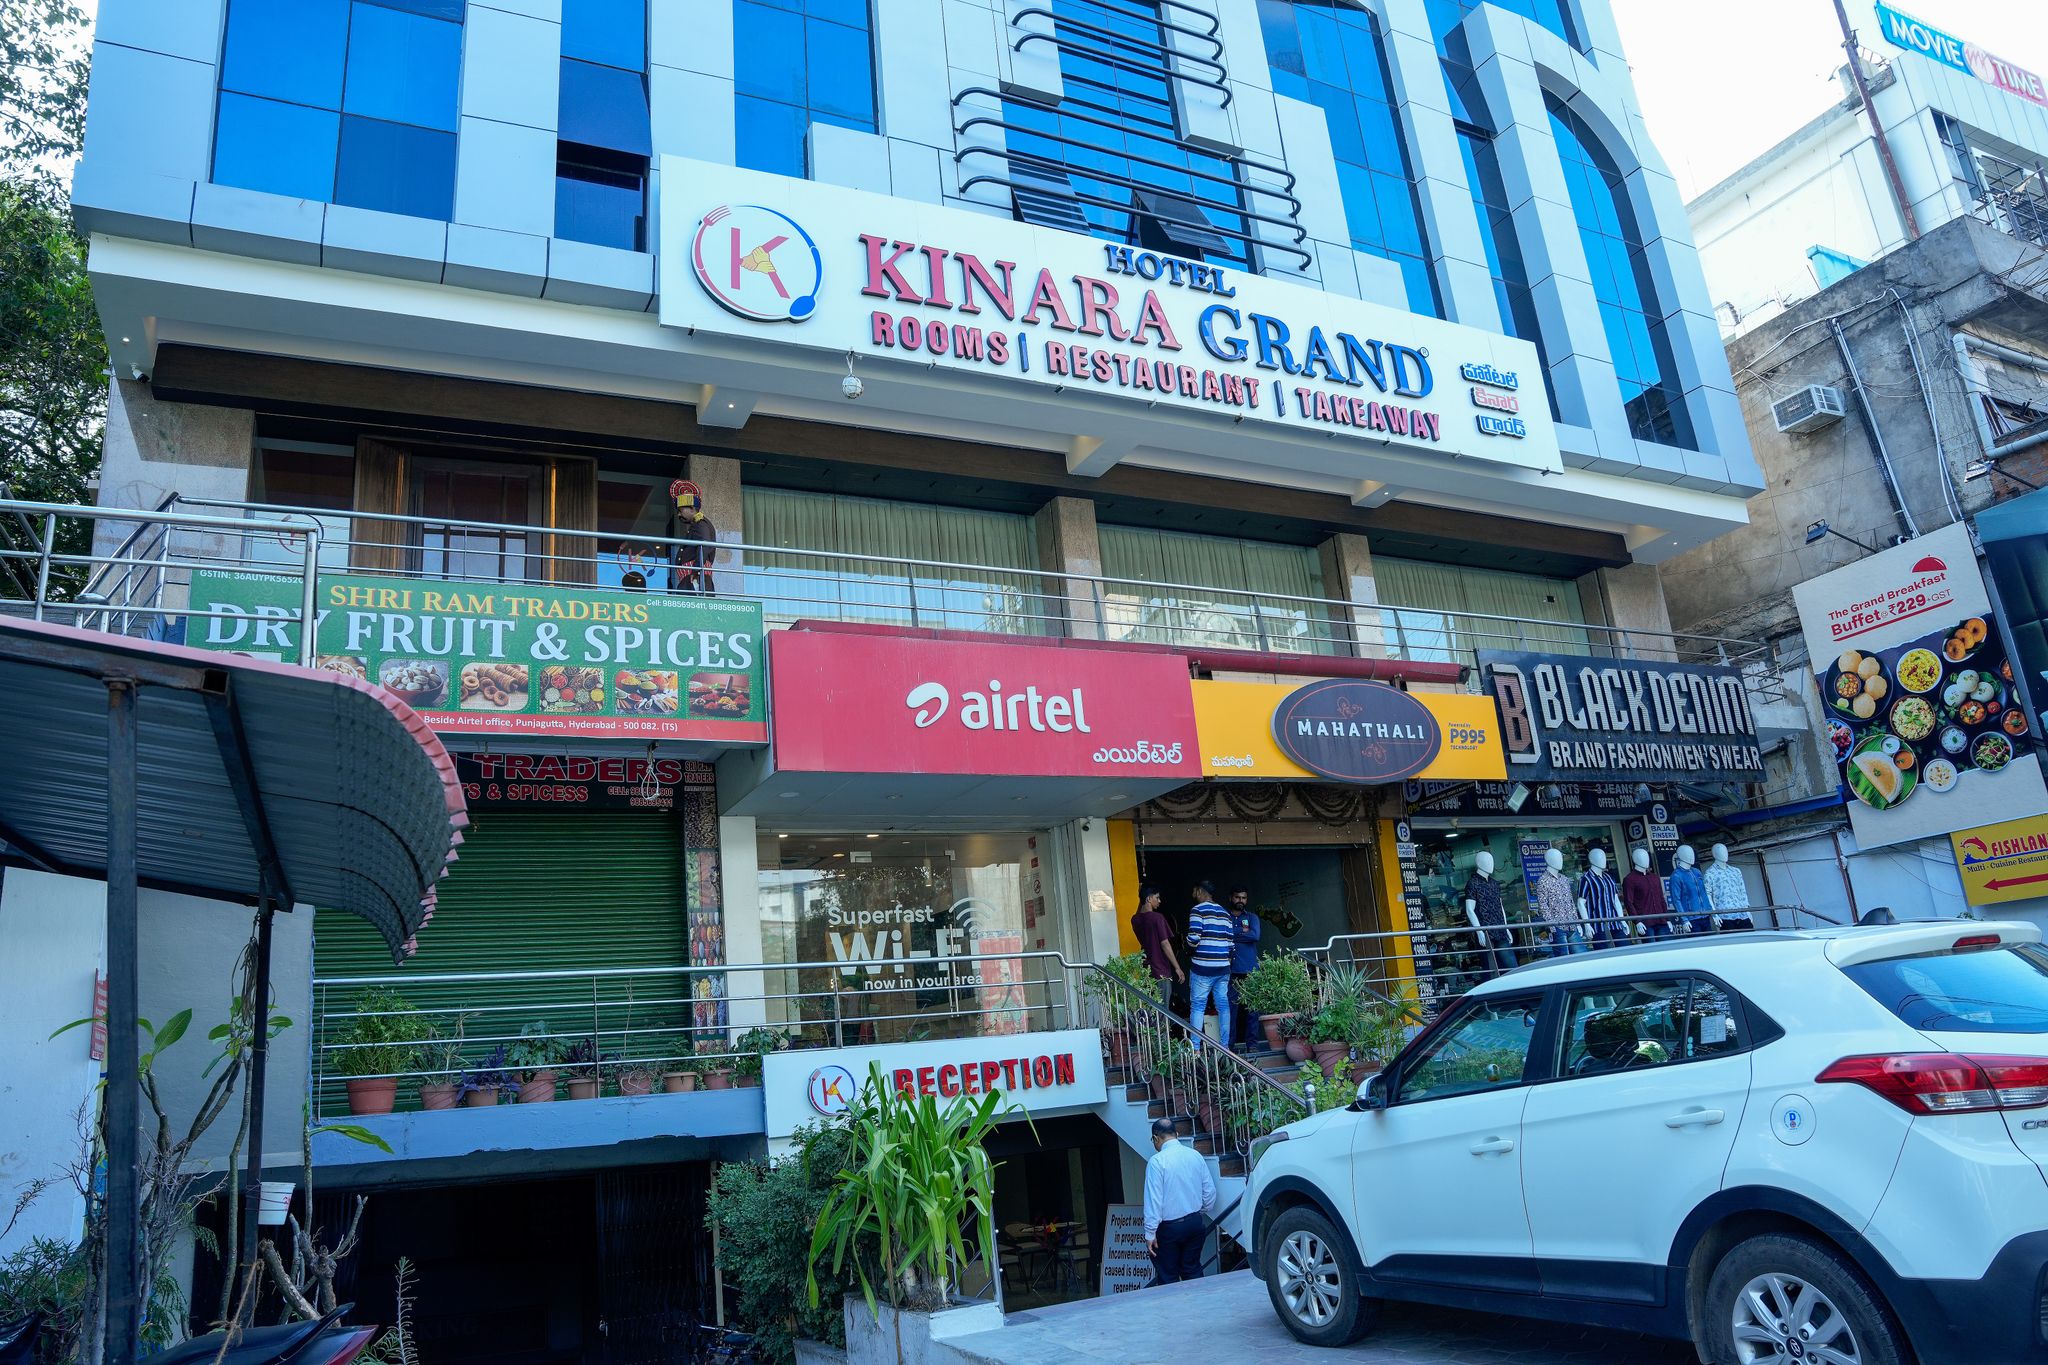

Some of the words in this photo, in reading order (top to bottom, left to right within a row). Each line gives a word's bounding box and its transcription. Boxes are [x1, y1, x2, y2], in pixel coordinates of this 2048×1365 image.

[1889, 12, 1965, 67] MOVIE
[1993, 60, 2045, 101] TIME
[1105, 244, 1236, 297] HOTEL
[858, 233, 1183, 351] KINARA
[871, 310, 1010, 366] ROOMS
[1045, 340, 1261, 410] RESTAURANT
[1295, 387, 1441, 442] TAKEAWAY
[200, 569, 231, 579] GSTIN:
[330, 585, 412, 609] SHRI
[422, 591, 495, 614] RAM
[504, 597, 649, 623] TRADERS
[646, 598, 661, 606] Cell:
[1828, 608, 1849, 621] The
[1850, 593, 1885, 614] Grand
[1887, 572, 1947, 600] Breakfast
[1831, 609, 1881, 636] Buffet
[345, 611, 515, 657] FRUIT
[530, 622, 570, 660] &
[584, 624, 752, 669] SPICES
[960, 679, 1091, 733] airtel
[1533, 663, 1652, 732] BLACK
[1647, 670, 1755, 735] DENIM
[424, 715, 455, 725] Beside
[457, 715, 483, 726] Airtel
[485, 717, 513, 728] office,
[516, 718, 566, 730] Punjagutta,
[569, 719, 616, 731] Hyderabad
[623, 721, 640, 730] 500
[641, 721, 660, 731] 082.
[662, 722, 678, 732] (TS)
[1297, 718, 1425, 740] MAHATHALI
[1450, 728, 1486, 744] P995
[1549, 740, 1608, 769] BRAND
[1608, 742, 1674, 770] FASHION
[1673, 744, 1721, 770] MEN'S
[1718, 745, 1763, 771] WEAR
[473, 753, 682, 785] TRADERS
[684, 772, 714, 784] TRADERS
[487, 783, 502, 800] &
[507, 783, 589, 802] SPICESS
[607, 786, 630, 796] CELL:
[1477, 798, 1498, 809] OFFER
[1598, 797, 1616, 808] OFFER
[1991, 832, 2048, 857] FISHLAN
[1967, 864, 1986, 873] Multi
[1990, 859, 2017, 869] Cuisine
[1406, 898, 1422, 906] OFFER
[828, 905, 935, 928] Superfast
[1411, 935, 1427, 943] OFFER
[829, 928, 981, 976] Wi-Fi
[864, 977, 896, 990] now
[900, 976, 913, 988] in
[916, 975, 950, 989] your
[953, 973, 984, 986] area
[893, 1053, 1075, 1102] RECEPTION
[1111, 1214, 1132, 1229] Project
[1132, 1216, 1145, 1227] wor
[1114, 1230, 1120, 1243] in
[1109, 1246, 1150, 1260] Inconvenience
[1104, 1263, 1125, 1277] caused
[1126, 1264, 1132, 1277] is
[1132, 1264, 1153, 1281] deeply
